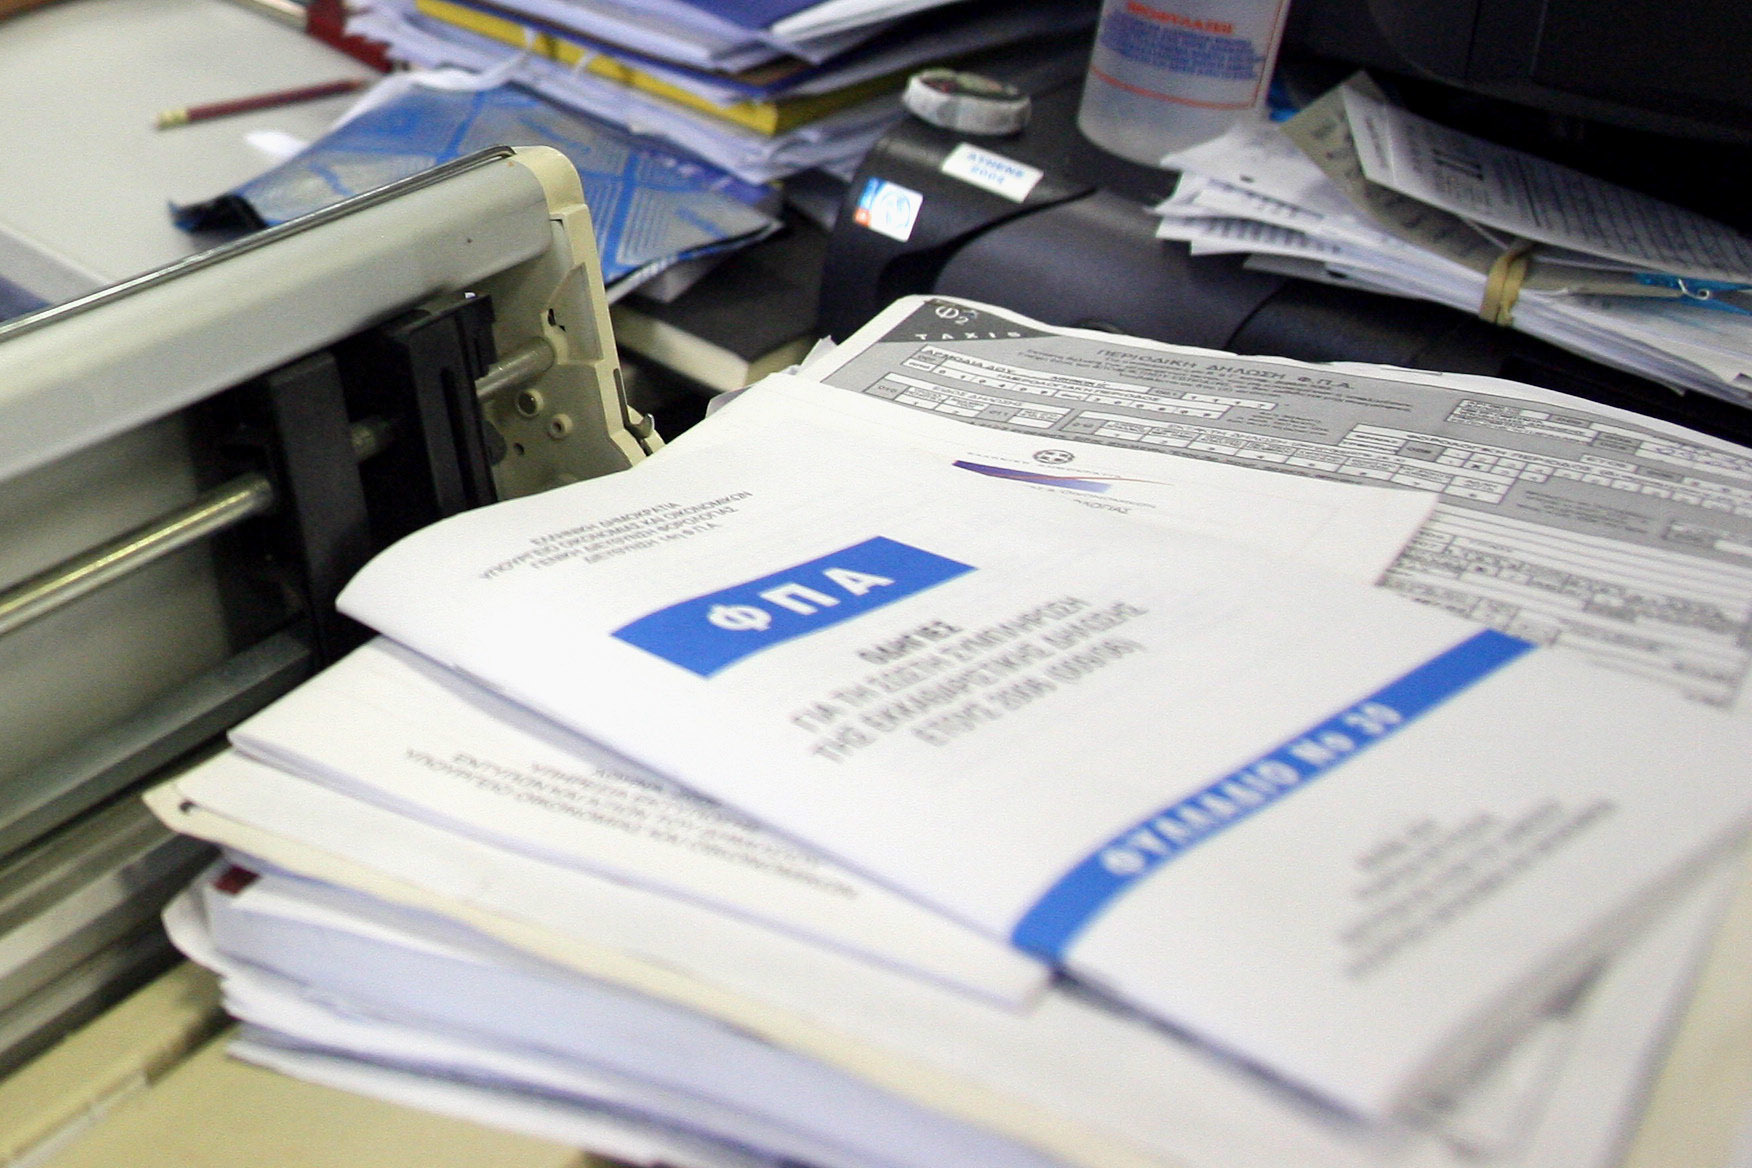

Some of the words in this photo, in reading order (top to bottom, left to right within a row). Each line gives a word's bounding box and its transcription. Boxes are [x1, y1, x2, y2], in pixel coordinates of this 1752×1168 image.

[1097, 348, 1197, 369] ΠΕΡΙΟΔΙΚΗ
[1206, 363, 1287, 381] ΔΗΛΩΣΗ
[598, 501, 683, 528] ΔΗΜΟΚΡΑΤΙΑ
[663, 490, 754, 521] ΟΙΚΟΝΟΜΙΚΩΝ
[789, 700, 847, 735] ΓΙΑ
[939, 595, 1093, 662] ΣΥΜΠΛΗΡΩΣΗ
[856, 618, 964, 666] ΟΔΗΓΙΕΣ
[811, 726, 879, 763] ΤΗΣ
[857, 641, 1055, 734] ΕΚΚΑΘΑΡΙΣΤΙΚΗΣ
[1041, 600, 1151, 650] ΔΗΛΩΣΗΣ
[1100, 759, 1301, 878] ΦΥΛΛΑΔΙΟ
